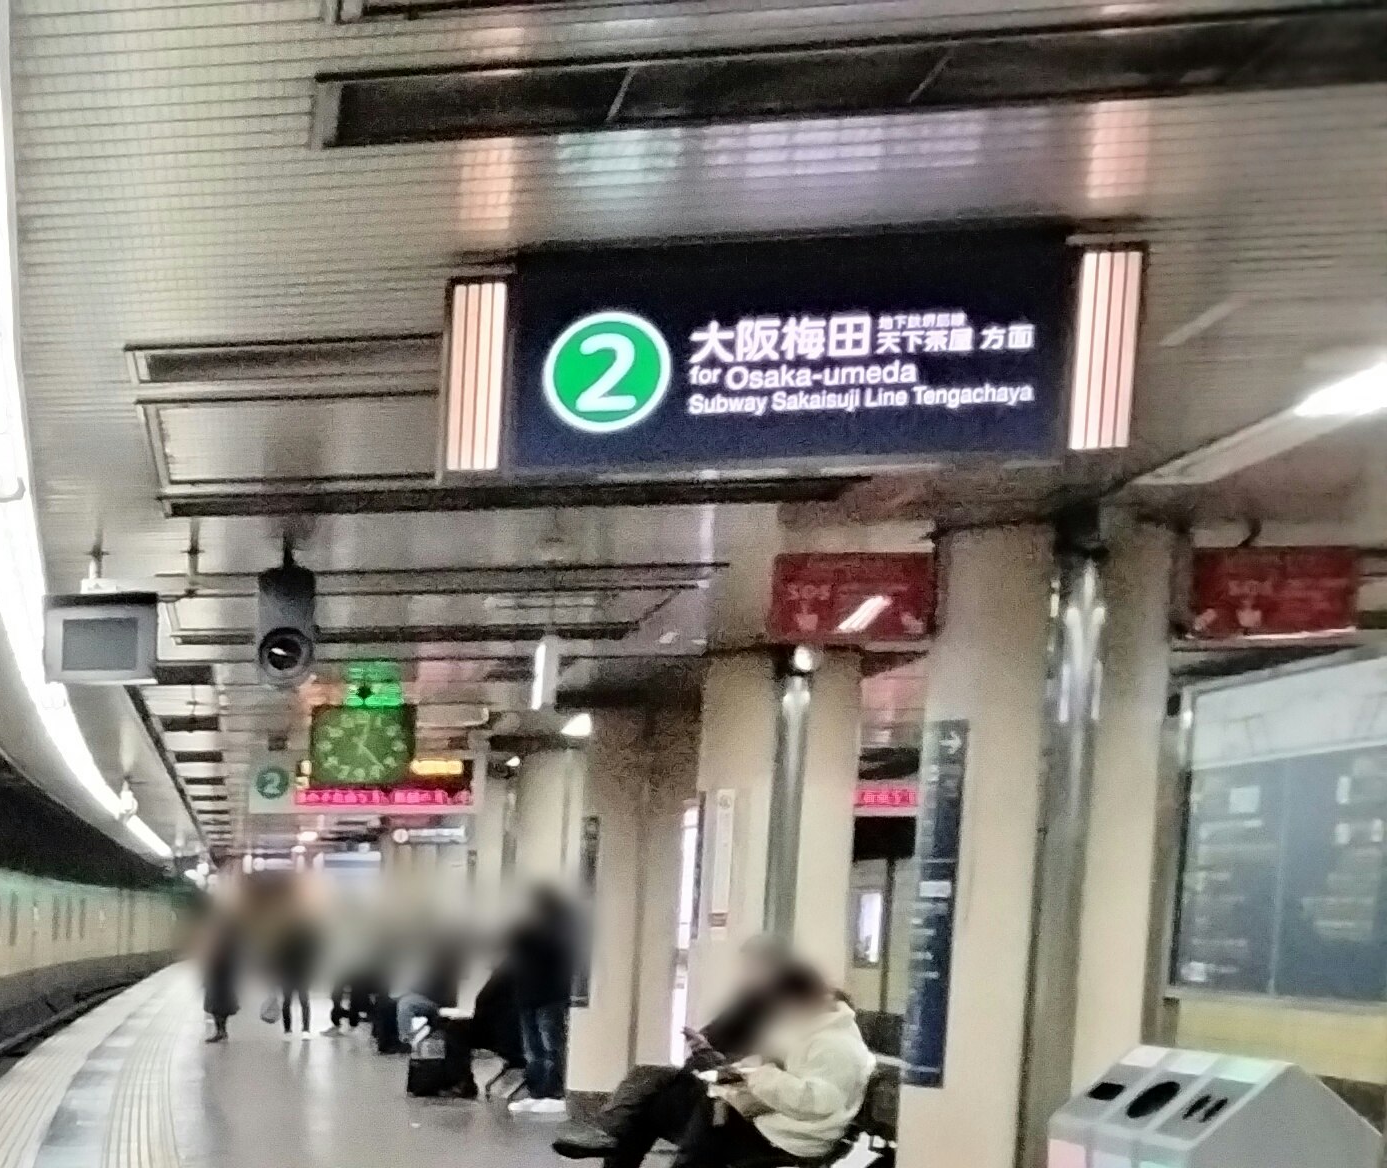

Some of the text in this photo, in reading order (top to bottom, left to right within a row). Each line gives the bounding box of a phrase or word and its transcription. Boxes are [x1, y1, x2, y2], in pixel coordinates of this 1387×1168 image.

[688, 316, 872, 363] 大阪梅田
[980, 324, 1034, 349] 方面
[576, 330, 638, 412] 2
[688, 360, 918, 390] for Osaka-umeda
[688, 382, 1034, 415] Subway Sakaisuji Line Tengachaya
[263, 773, 282, 794] 2
